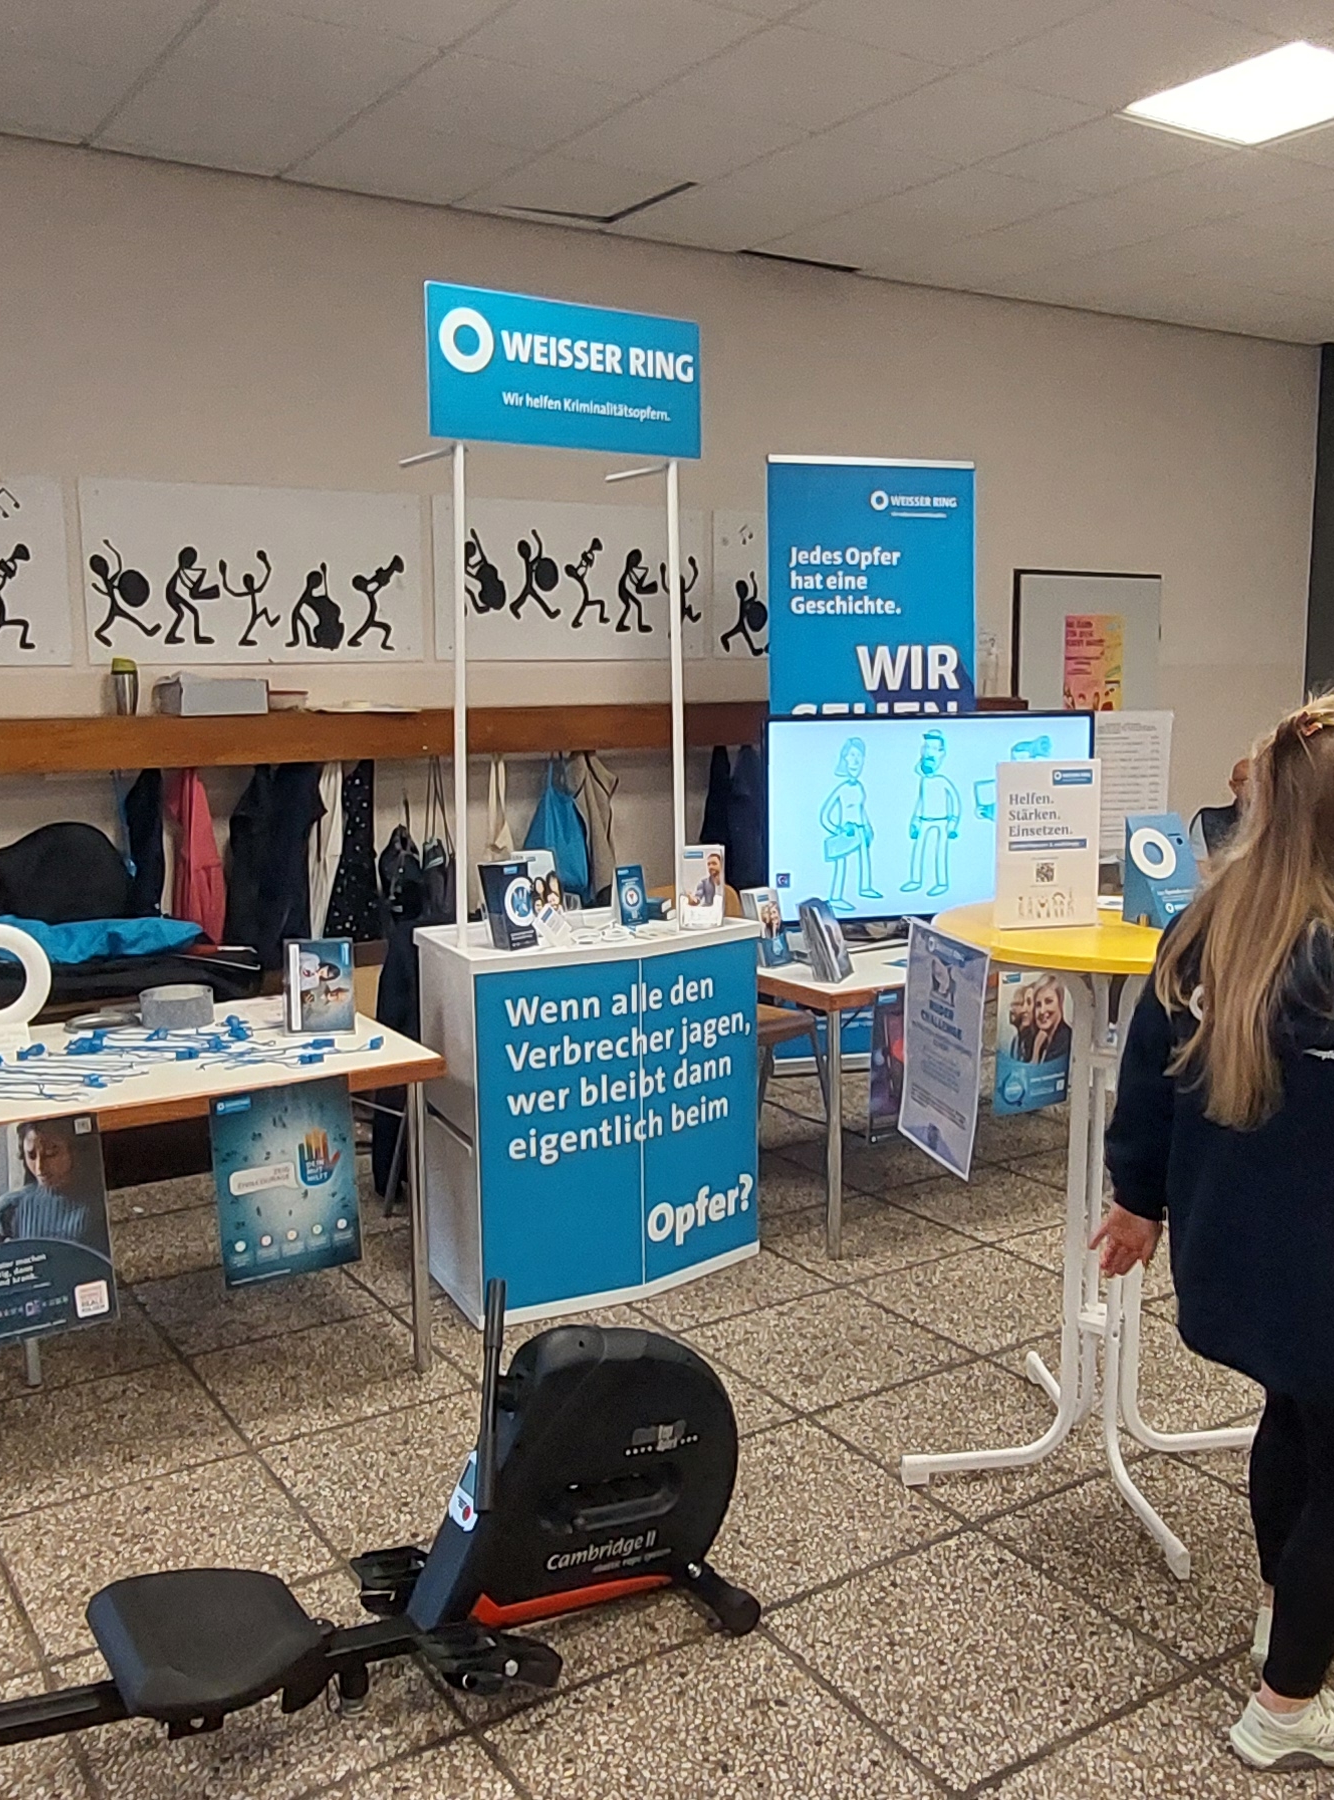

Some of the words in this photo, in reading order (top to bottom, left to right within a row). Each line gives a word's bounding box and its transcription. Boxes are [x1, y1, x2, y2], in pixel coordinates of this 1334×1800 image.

[500, 329, 624, 376] WEISSER
[628, 346, 695, 384] RING
[502, 391, 524, 407] Wir
[526, 394, 562, 412] helfen
[890, 494, 932, 508] WEISSER
[932, 496, 958, 508] RING
[789, 545, 843, 568] Jedes
[845, 546, 901, 570] Opfer
[790, 570, 824, 590] hat
[826, 571, 868, 590] eine
[790, 595, 902, 615] Geschichte.
[855, 644, 961, 692] WIR
[1008, 792, 1055, 806] Helfen.
[1008, 808, 1061, 822] Stärken.
[1008, 824, 1073, 838] Einsetzen.
[504, 994, 601, 1028] Wenn
[611, 981, 663, 1016] alle
[669, 974, 714, 1006] den
[504, 1026, 674, 1073] Verbrecher
[678, 1011, 752, 1055] jagen,
[506, 1086, 571, 1117] wer
[579, 1066, 666, 1107] bleibt
[673, 1055, 732, 1090] dann
[508, 1108, 663, 1166] eigentlich
[670, 1095, 729, 1132] beim
[647, 1173, 754, 1247] Opfer?
[546, 1535, 644, 1571] Cambridge
